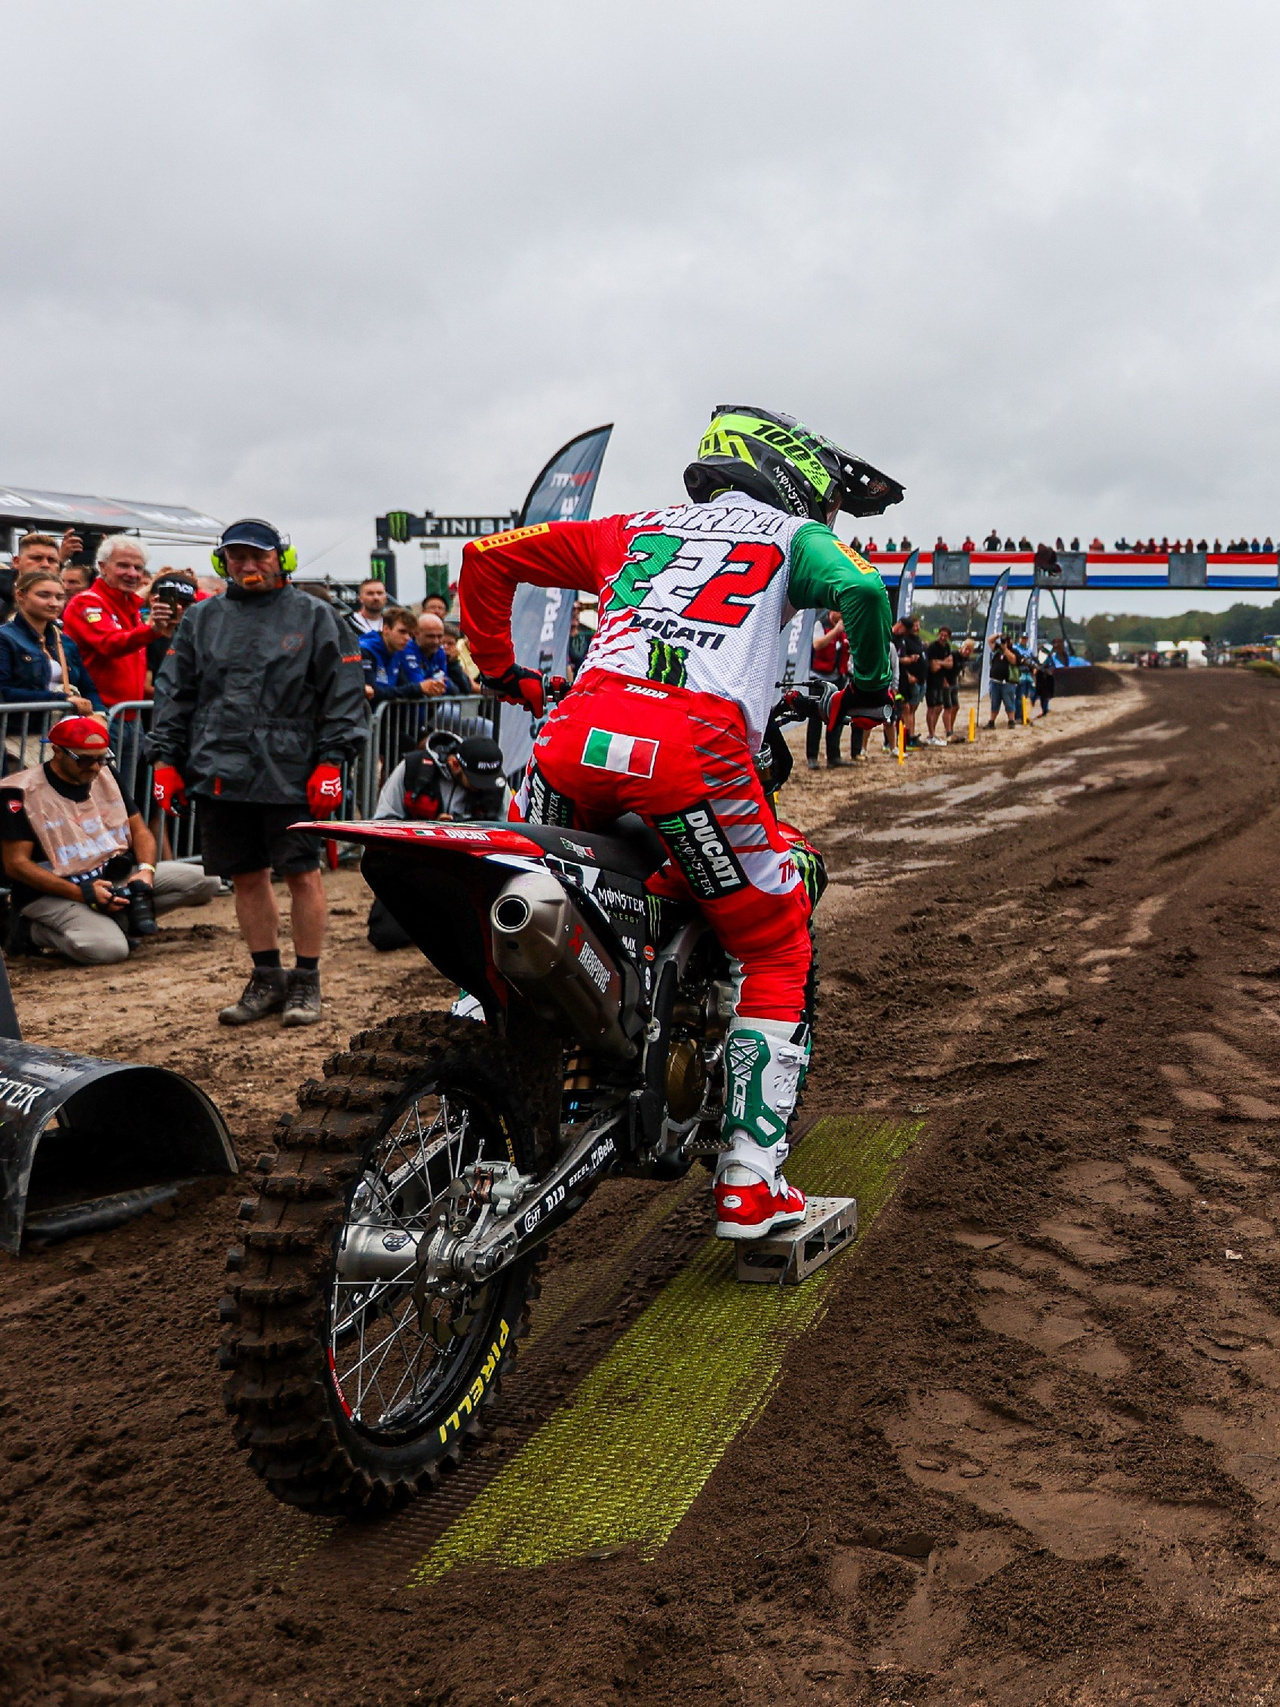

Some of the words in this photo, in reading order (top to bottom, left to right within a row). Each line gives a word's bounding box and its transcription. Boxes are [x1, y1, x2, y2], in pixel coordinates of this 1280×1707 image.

[425, 518, 515, 536] FINISH
[605, 533, 786, 628] 222
[624, 682, 670, 700] THOR
[443, 828, 491, 842] DUCATI
[685, 809, 742, 888] DUCATI
[677, 835, 716, 896] MONSTER
[597, 887, 647, 916] MONSTER
[569, 1163, 590, 1187] EXCEL
[439, 1318, 510, 1444] PIRELLI
